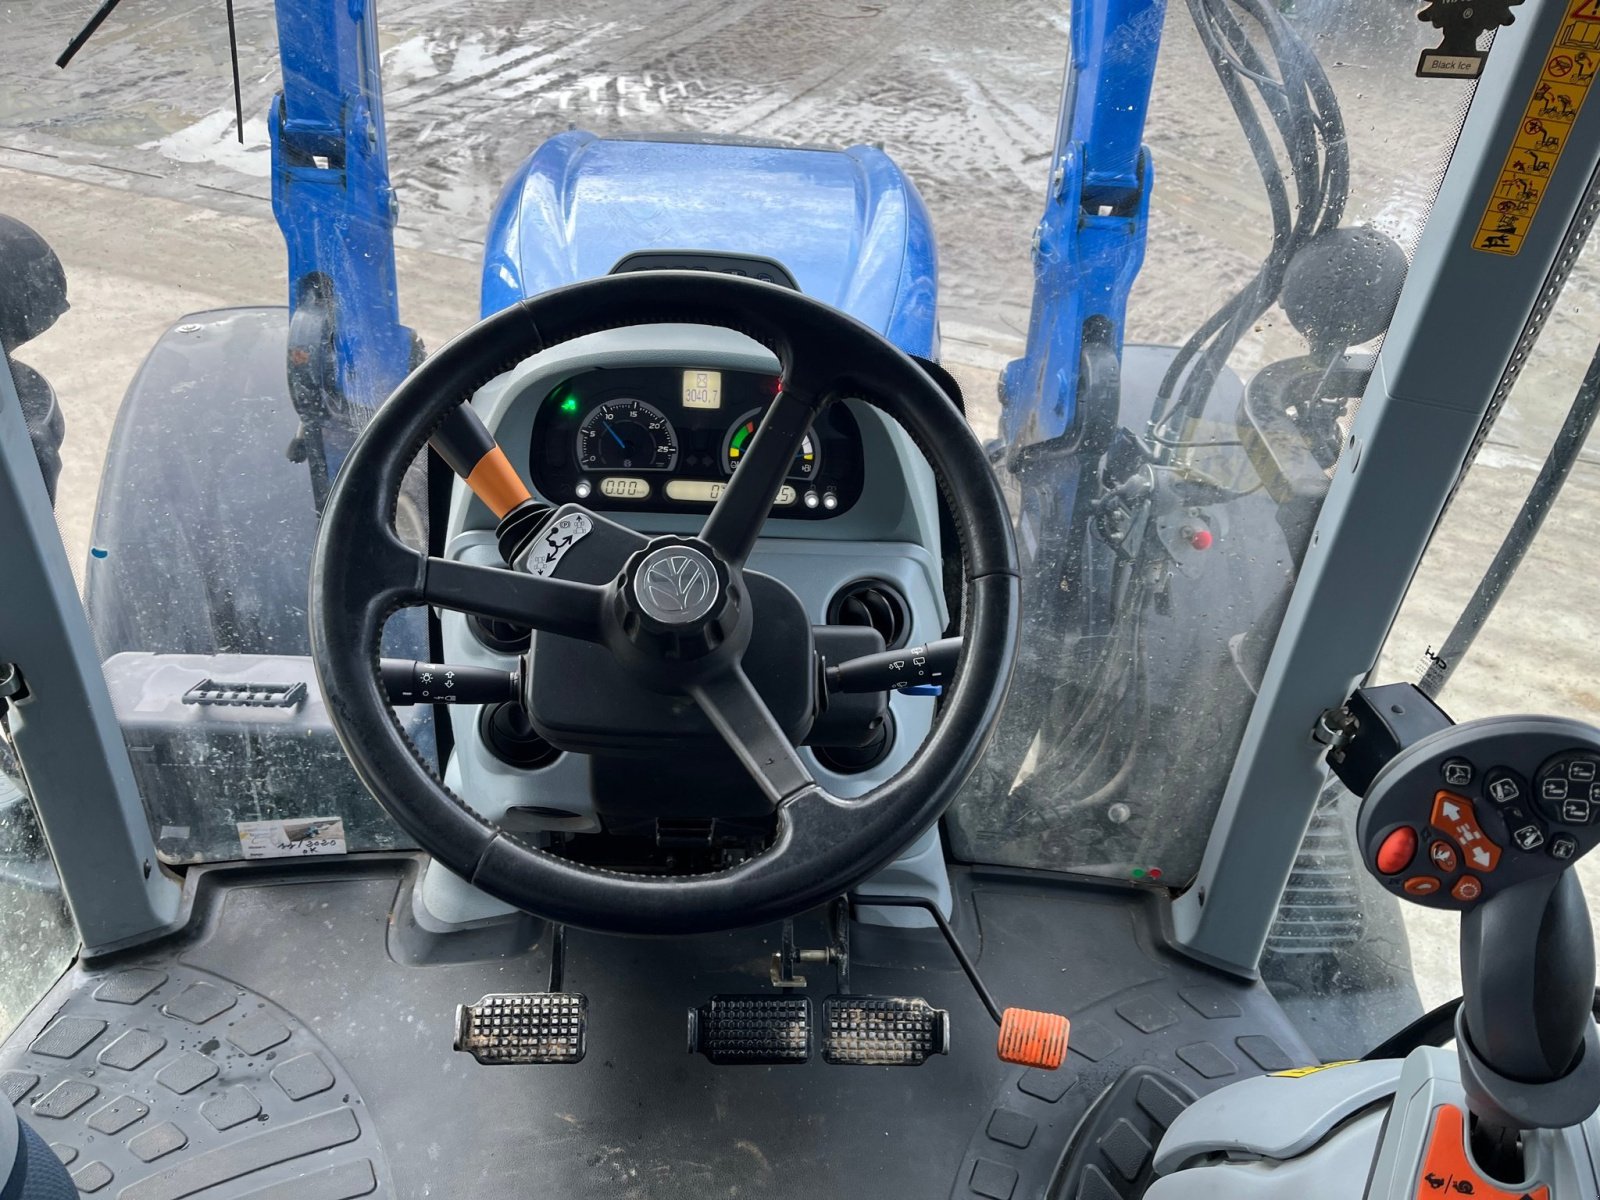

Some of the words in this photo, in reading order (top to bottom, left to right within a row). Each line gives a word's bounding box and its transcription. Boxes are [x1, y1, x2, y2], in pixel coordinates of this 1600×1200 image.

[1431, 60, 1456, 69] Black
[1458, 61, 1472, 70] Ice
[685, 388, 718, 403] 3040.7
[648, 422, 660, 430] 20
[589, 430, 596, 438] 5
[657, 445, 669, 453] 25
[605, 480, 637, 496] 0.00
